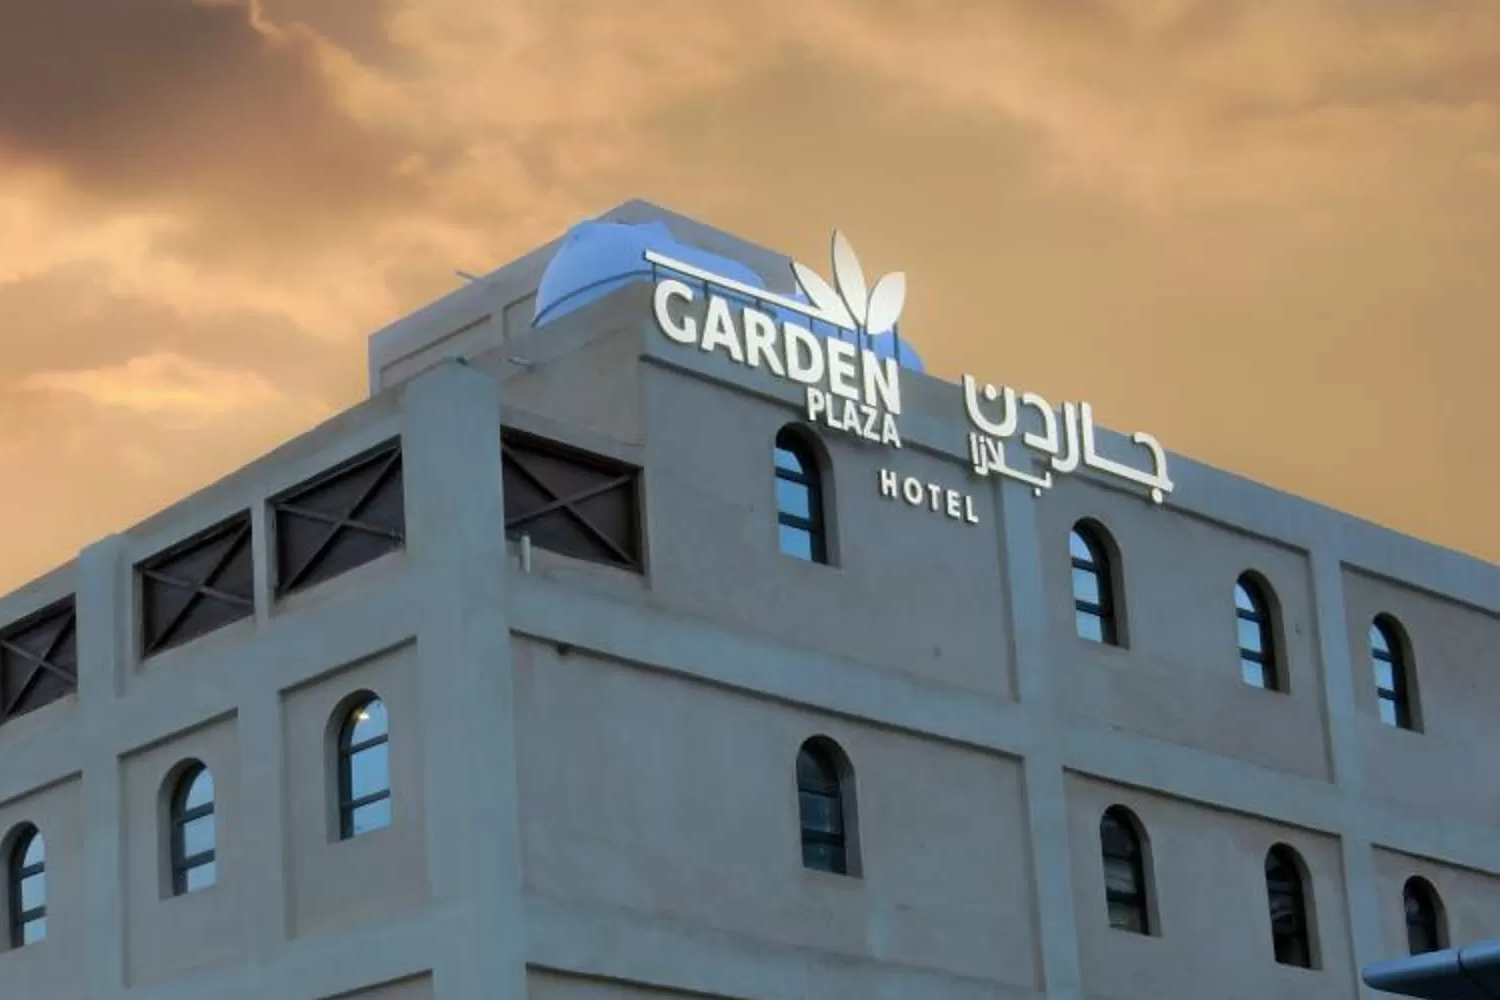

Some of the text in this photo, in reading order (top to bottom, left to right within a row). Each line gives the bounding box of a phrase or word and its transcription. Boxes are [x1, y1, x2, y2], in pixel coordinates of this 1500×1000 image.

[654, 279, 901, 415] GARDEN
[807, 386, 901, 448] PLAZA
[879, 469, 979, 524] HOTEL
